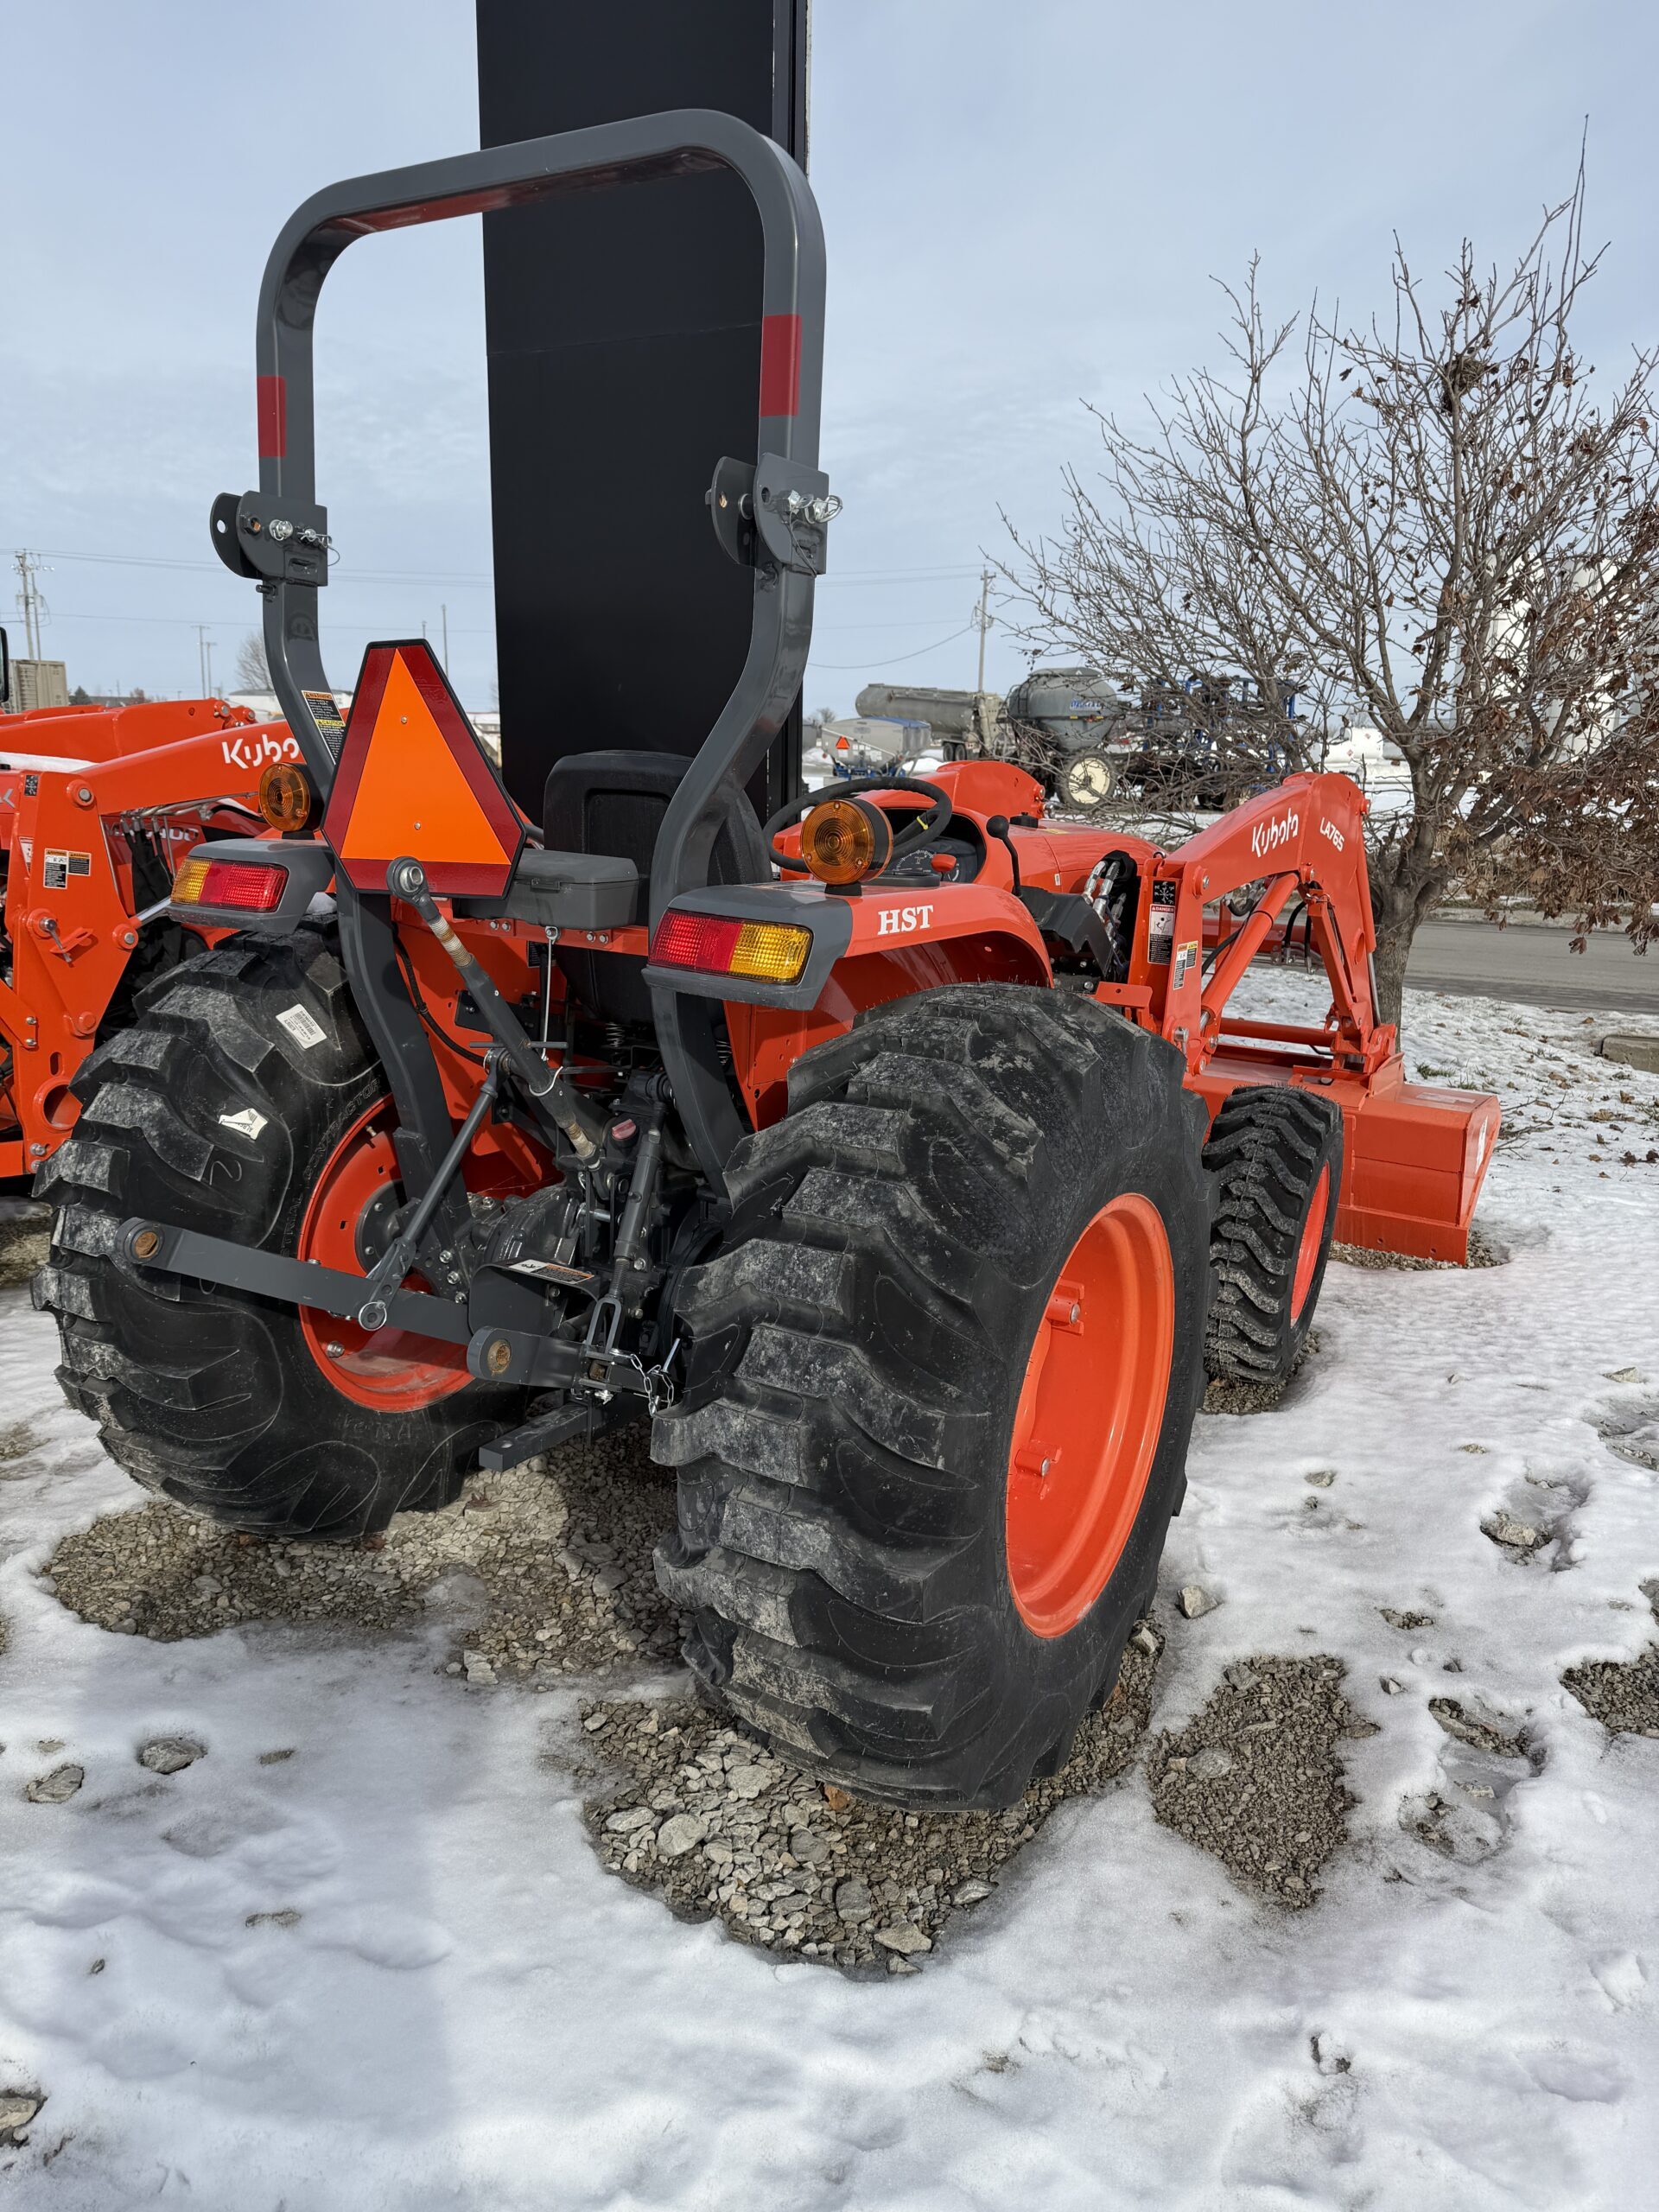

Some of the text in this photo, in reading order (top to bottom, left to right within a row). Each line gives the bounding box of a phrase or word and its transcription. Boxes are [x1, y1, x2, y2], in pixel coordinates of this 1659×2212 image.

[1252, 807, 1299, 858] Kubota
[1319, 817, 1345, 853] LA765
[877, 905, 934, 936] HST
